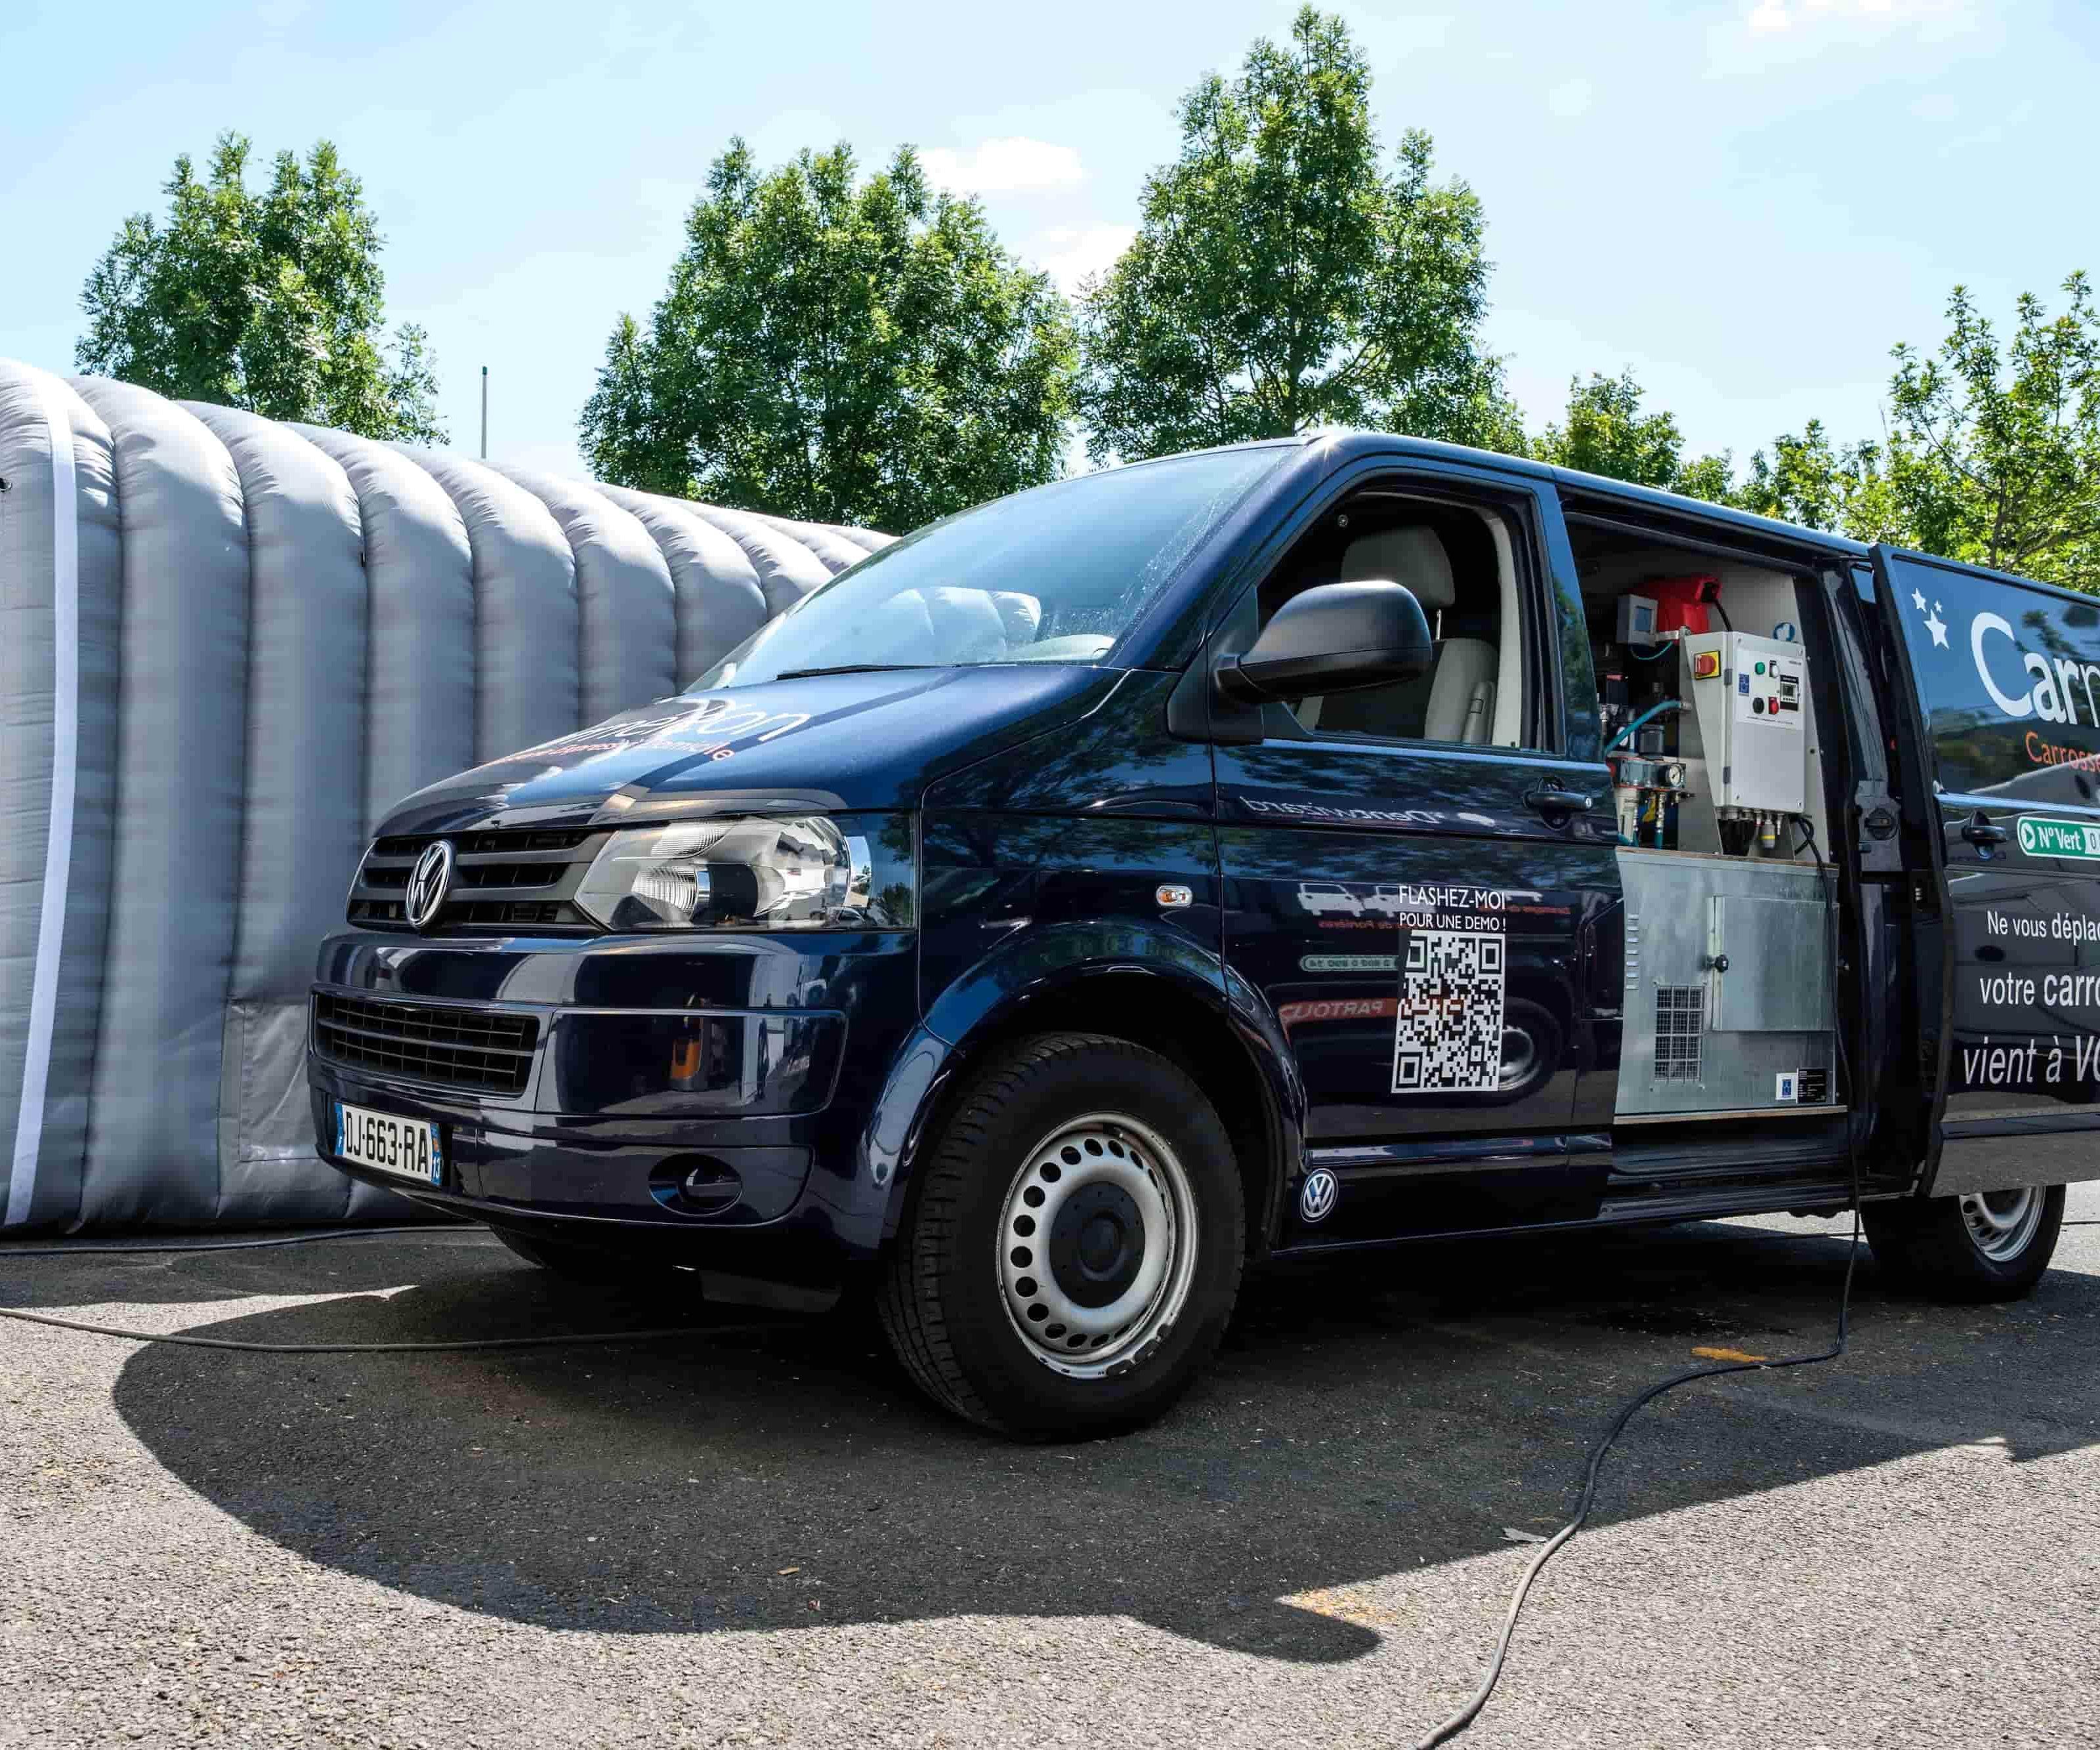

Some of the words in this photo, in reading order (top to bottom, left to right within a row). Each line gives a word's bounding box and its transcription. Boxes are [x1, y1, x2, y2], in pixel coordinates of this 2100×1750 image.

[1398, 886, 1505, 910] FLASHEZ-MOI
[1399, 912, 1433, 928] POUR
[1437, 915, 1461, 929] UNE
[1465, 916, 1500, 930] DEMO
[1987, 910, 2008, 935] Ne
[2012, 918, 2047, 938] vous
[1979, 971, 2035, 1005] votre
[1964, 1036, 2037, 1084] vient
[2046, 1035, 2062, 1083] à
